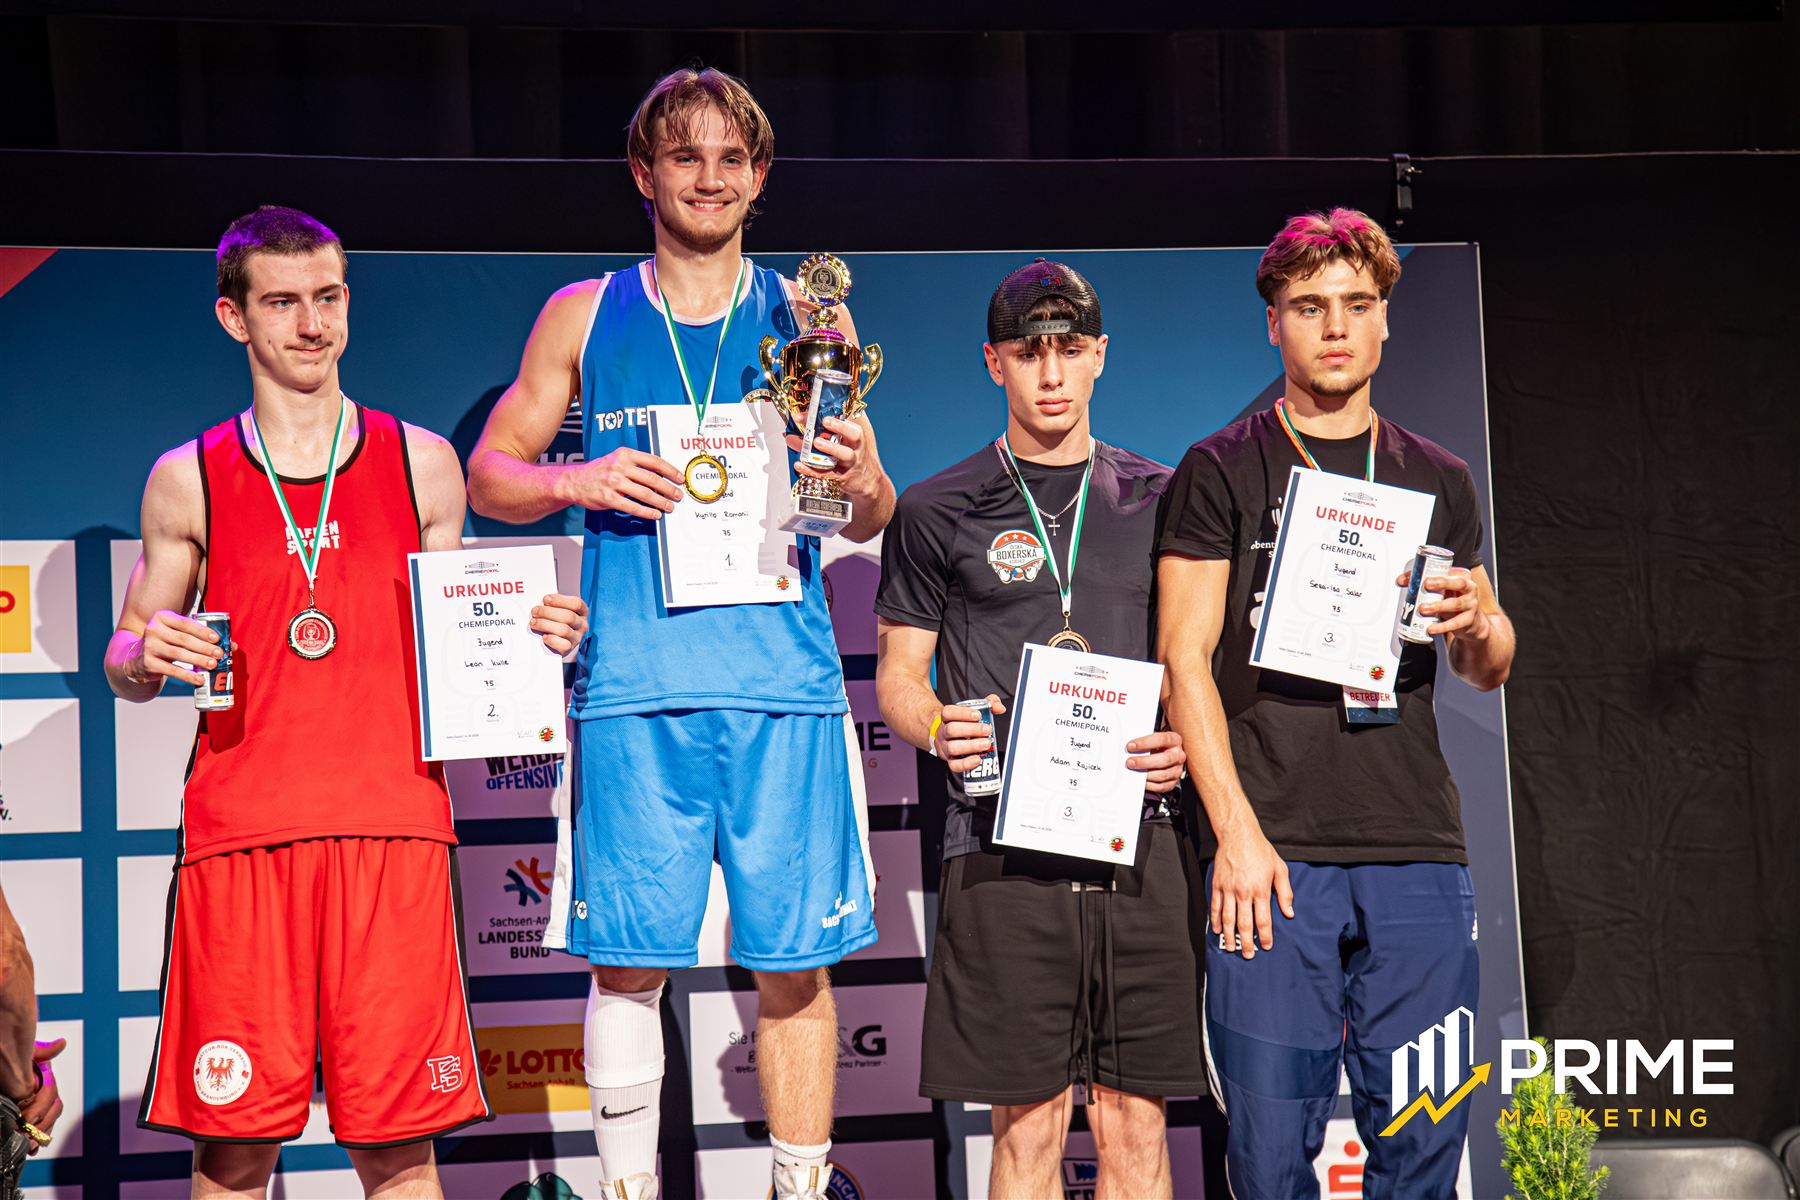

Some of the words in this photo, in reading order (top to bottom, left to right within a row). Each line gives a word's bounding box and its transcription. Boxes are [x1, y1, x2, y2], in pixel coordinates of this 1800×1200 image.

[624, 407, 647, 426] TE
[680, 436, 756, 450] URKUNDE
[695, 472, 748, 480] CHEMIOKAL
[1315, 506, 1396, 534] URKUNDE
[1338, 529, 1364, 547] 50.
[1320, 543, 1377, 562] CHEMIEPOKAL
[443, 581, 525, 598] URKUNDE
[472, 601, 500, 617] 50.
[458, 618, 517, 629] CHEMIEPOKAL
[1048, 681, 1128, 706] URKUNDE
[1349, 692, 1391, 702] BETREUER
[1071, 702, 1097, 721] 50.
[1055, 718, 1111, 734] CHEMIEPOKAL
[489, 916, 551, 928] Sachsen-An
[478, 928, 543, 945] LANDESS
[510, 946, 551, 960] BUND
[729, 1032, 748, 1046] Sie
